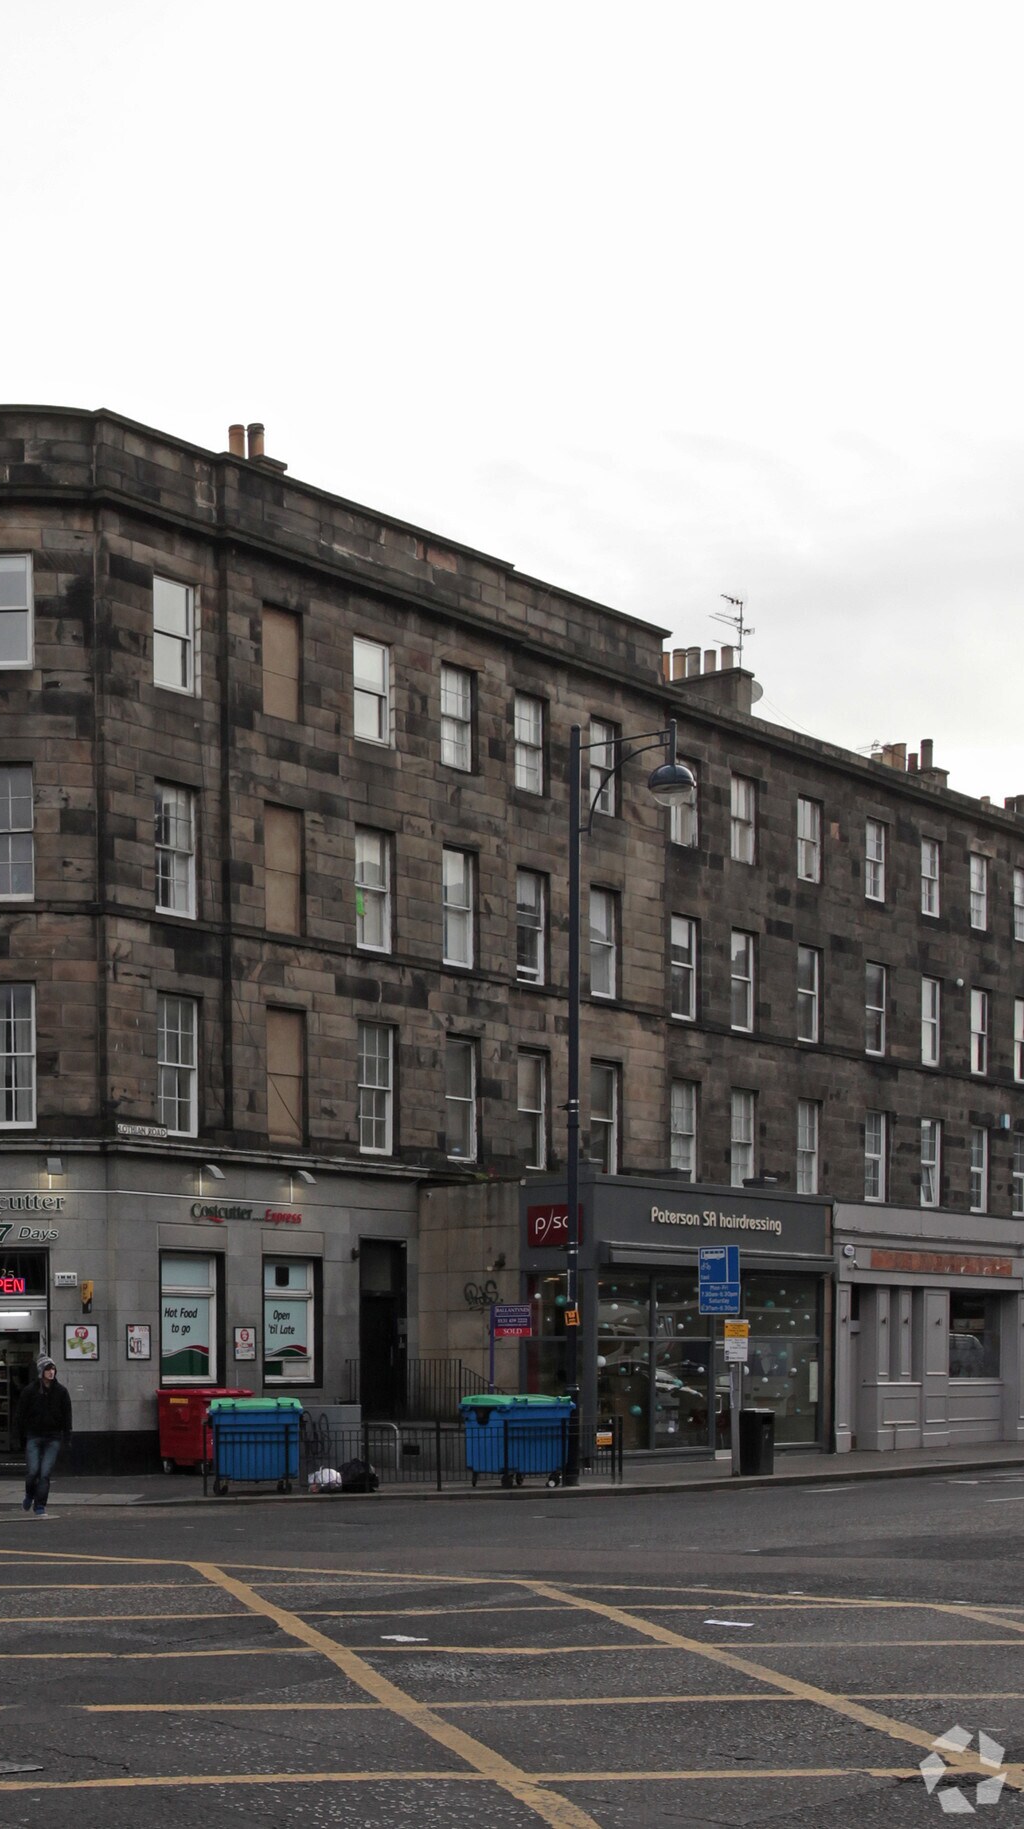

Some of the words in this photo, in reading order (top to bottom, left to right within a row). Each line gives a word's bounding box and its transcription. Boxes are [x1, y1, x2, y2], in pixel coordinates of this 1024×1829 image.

[118, 1124, 146, 1135] LOTHIAN
[148, 1128, 166, 1137] ROAD
[651, 1206, 700, 1226] Paterson
[702, 1211, 717, 1227] SA
[719, 1212, 782, 1235] hairdressing
[19, 1227, 58, 1241] Days
[164, 1307, 178, 1318] Hot
[180, 1307, 198, 1318] Food
[273, 1310, 290, 1322] Open
[171, 1323, 180, 1333] to
[181, 1325, 191, 1336] go
[280, 1325, 295, 1335] Late
